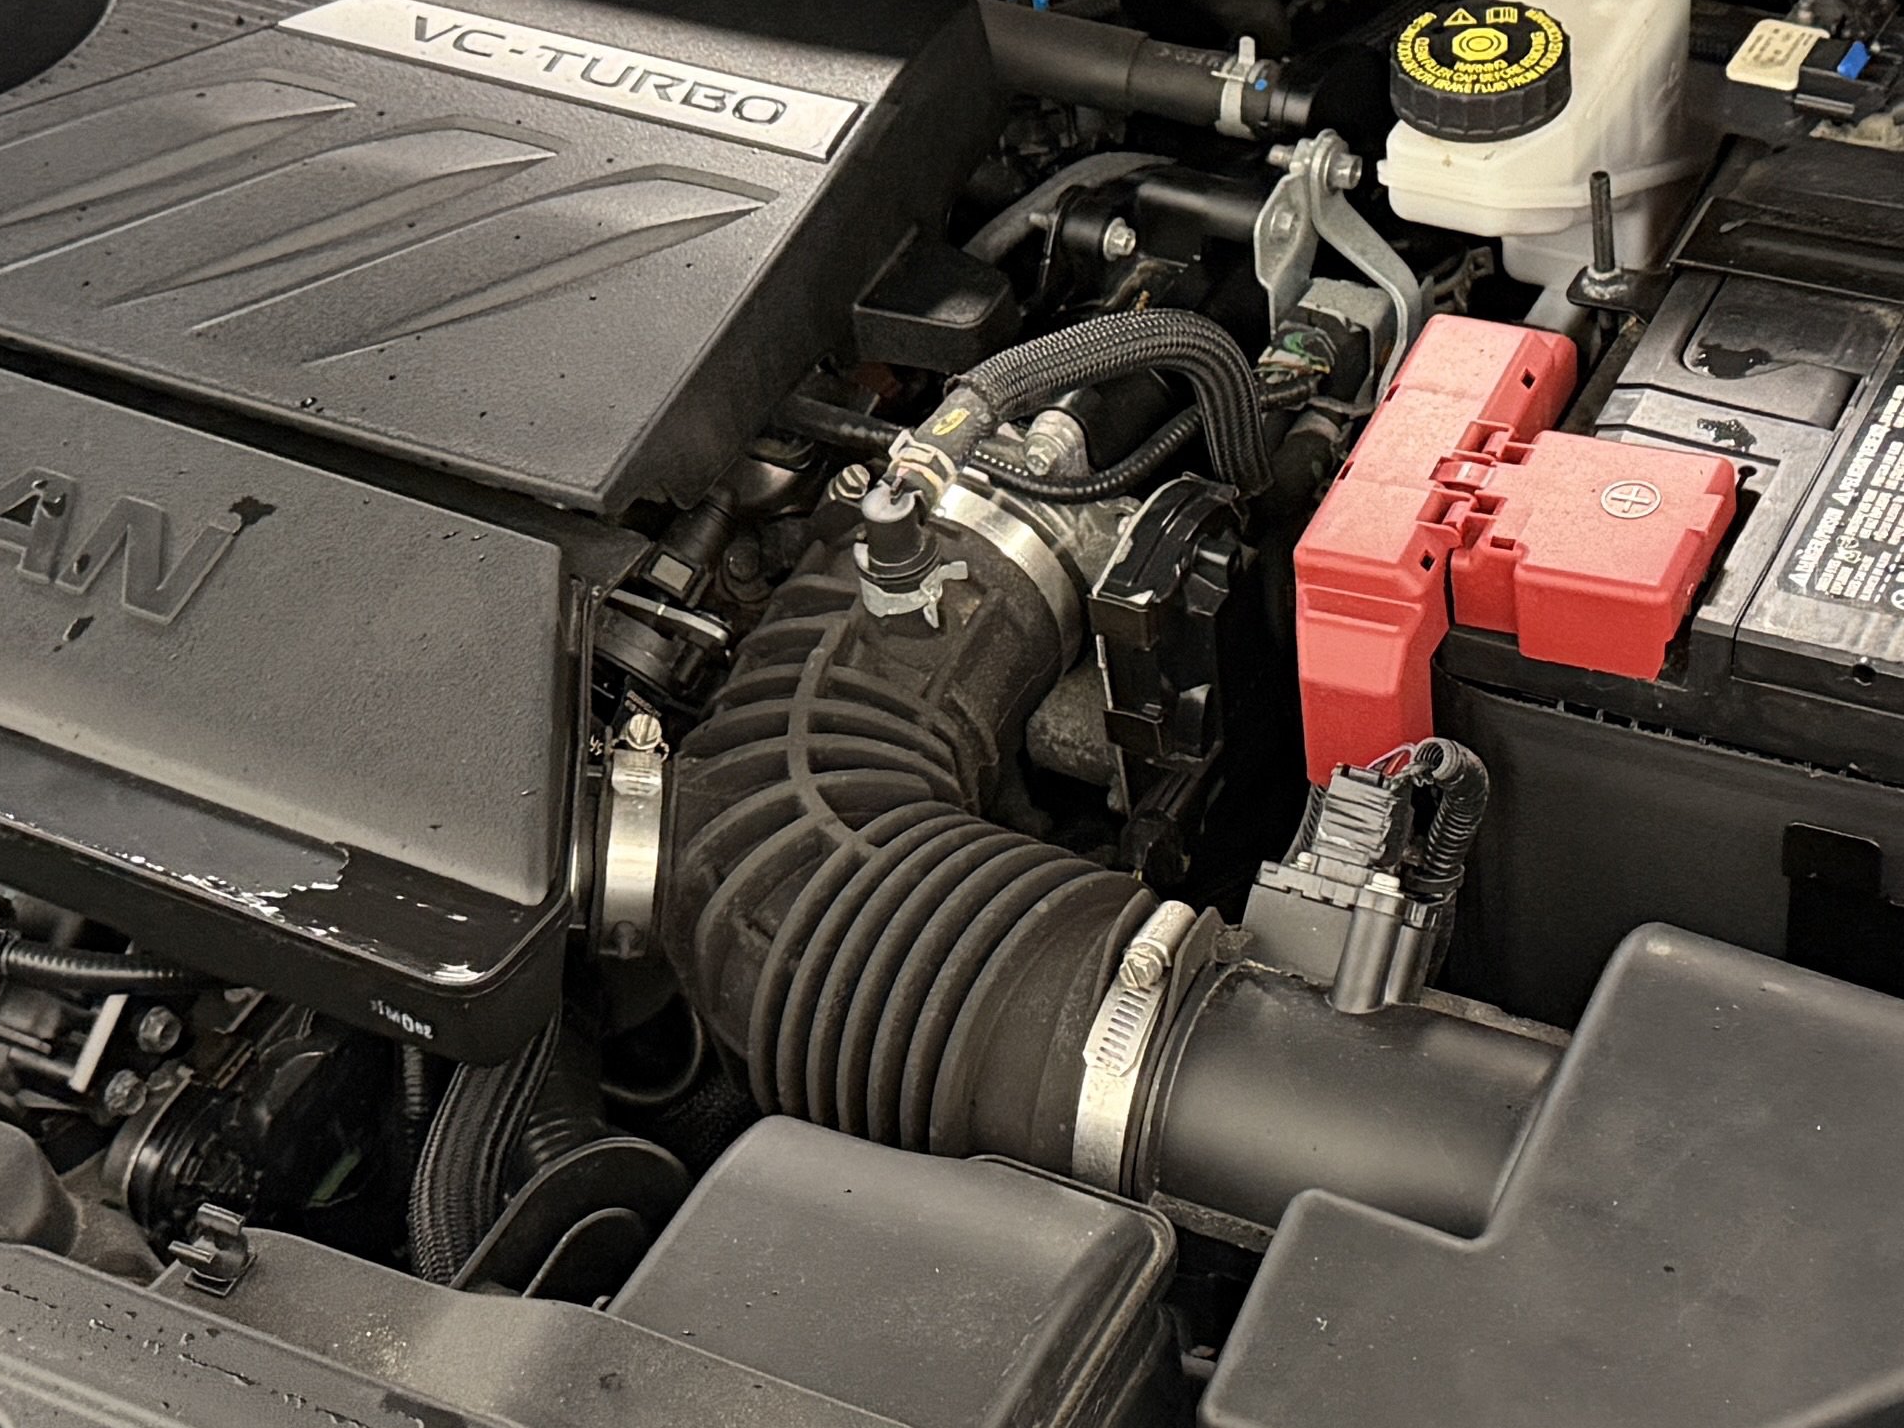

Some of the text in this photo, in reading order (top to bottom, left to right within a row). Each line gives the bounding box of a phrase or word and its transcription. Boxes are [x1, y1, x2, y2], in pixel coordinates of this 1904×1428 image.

[414, 15, 788, 126] VC-TURBO
[1451, 71, 1477, 83] CAP
[1474, 80, 1511, 93] FLUID
